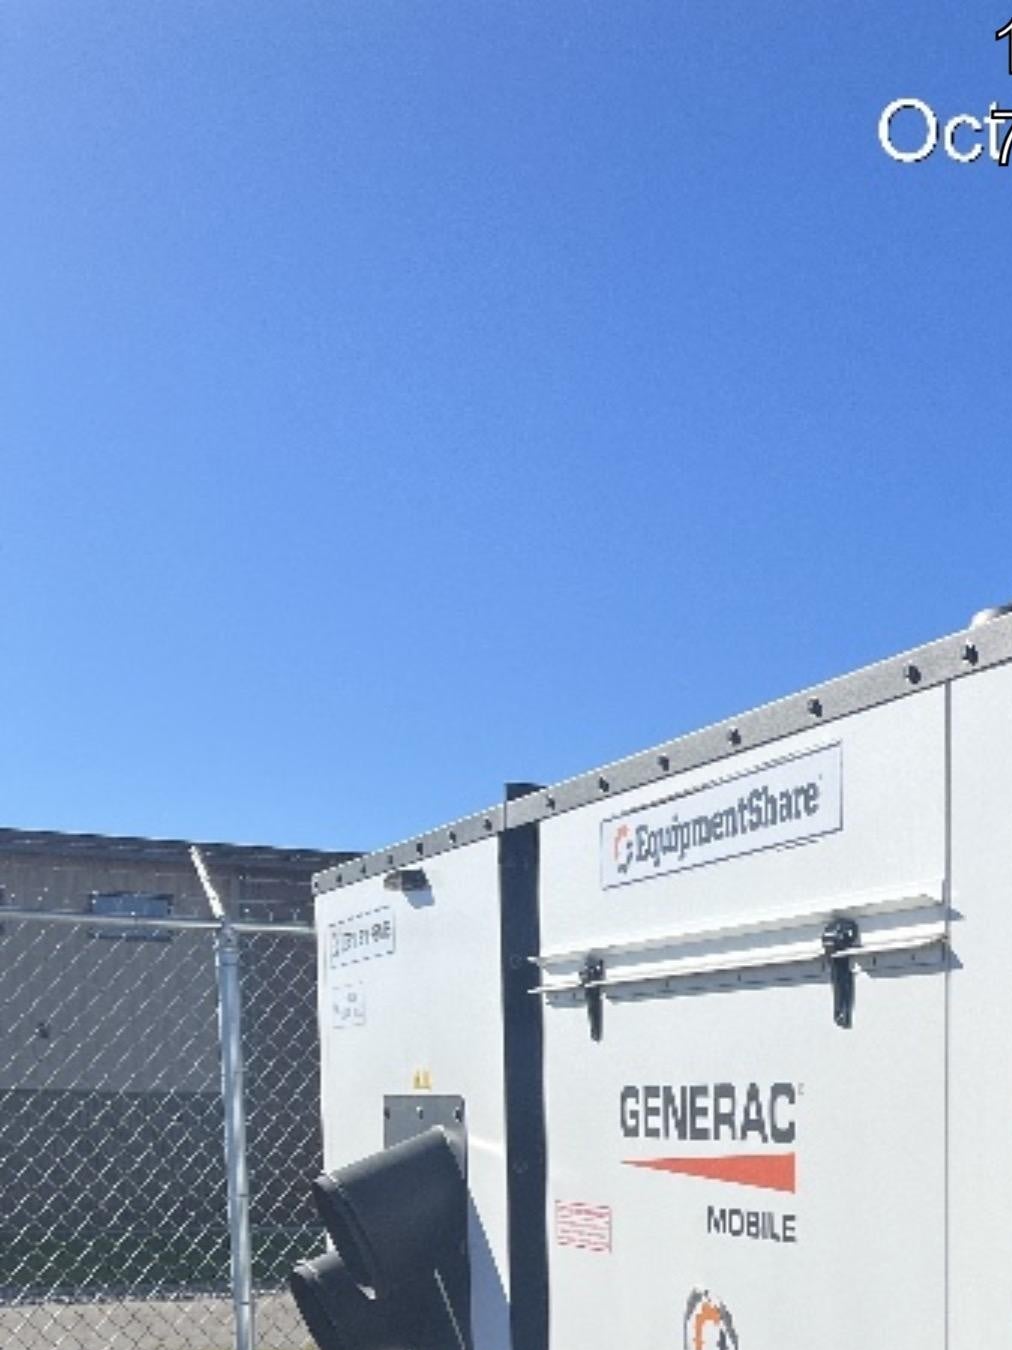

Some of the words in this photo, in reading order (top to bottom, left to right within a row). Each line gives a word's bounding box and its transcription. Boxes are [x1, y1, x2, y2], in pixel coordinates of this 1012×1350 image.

[635, 782, 820, 867] EquipmentShare
[620, 1082, 796, 1144] GENERAC
[707, 1205, 797, 1243] MOBILE
